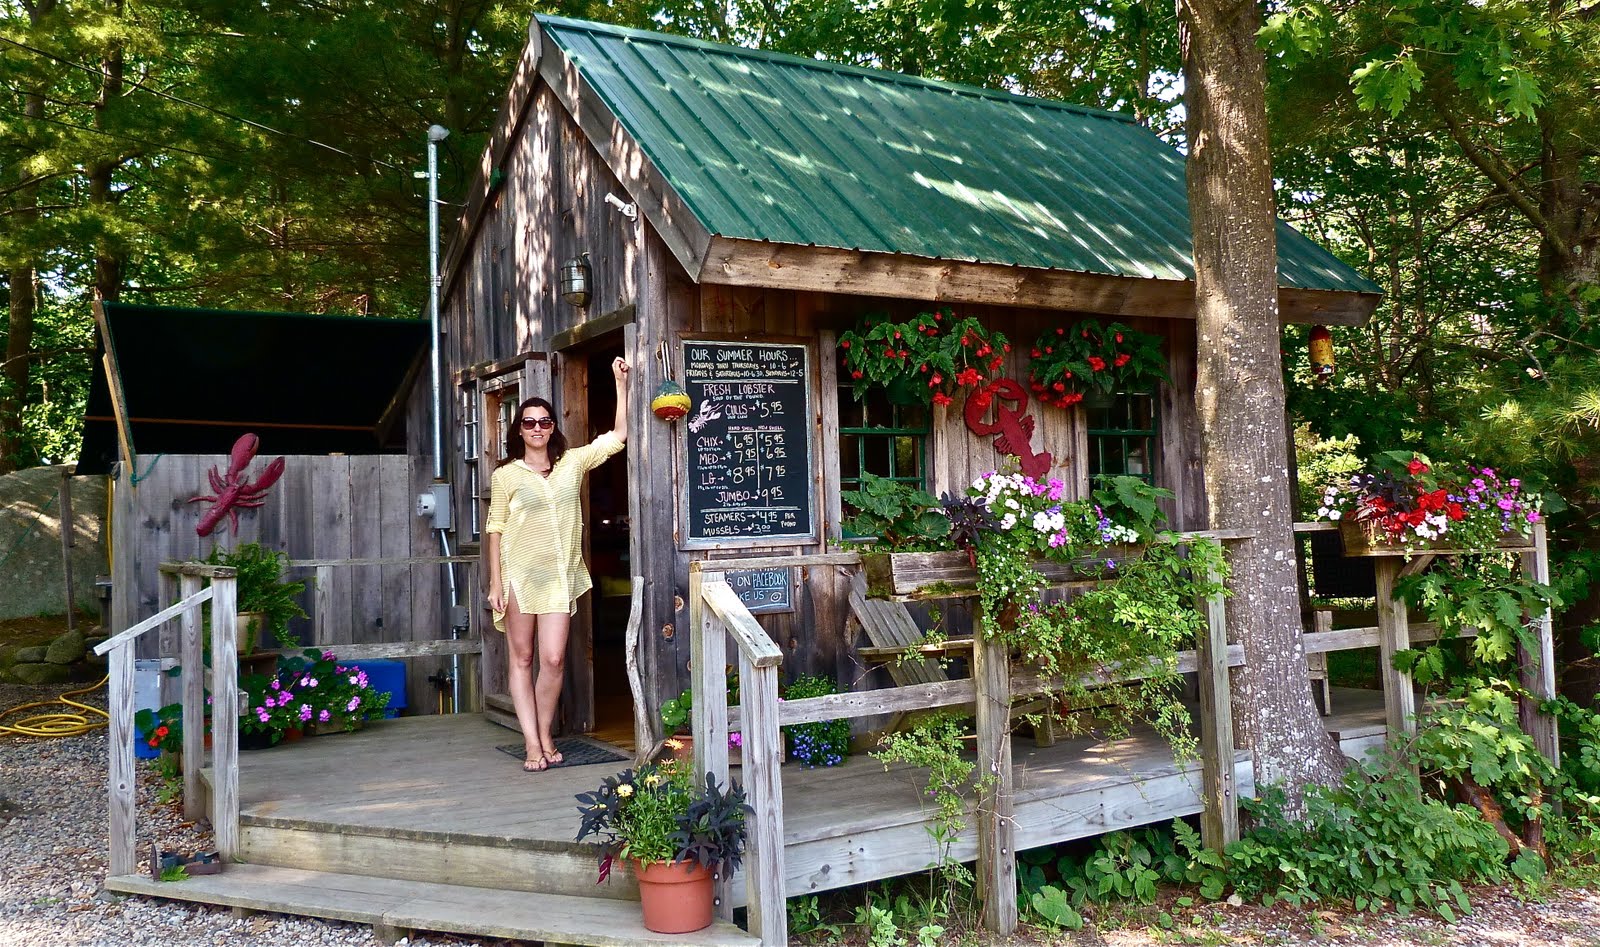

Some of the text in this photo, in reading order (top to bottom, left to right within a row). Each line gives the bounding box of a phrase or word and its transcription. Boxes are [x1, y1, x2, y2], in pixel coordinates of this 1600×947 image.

[691, 349, 711, 361] OUR
[716, 349, 753, 362] SUMMER
[703, 384, 775, 397] FRESH LOBSTER
[725, 404, 748, 416] CULLS
[696, 436, 719, 448] CHIX
[699, 453, 719, 466] MED
[715, 491, 750, 503] JUMBO
[704, 512, 747, 525] STEAMERS
[702, 525, 741, 537] MUSSELS
[737, 575, 751, 587] ON
[752, 571, 787, 588] FACEBOOK
